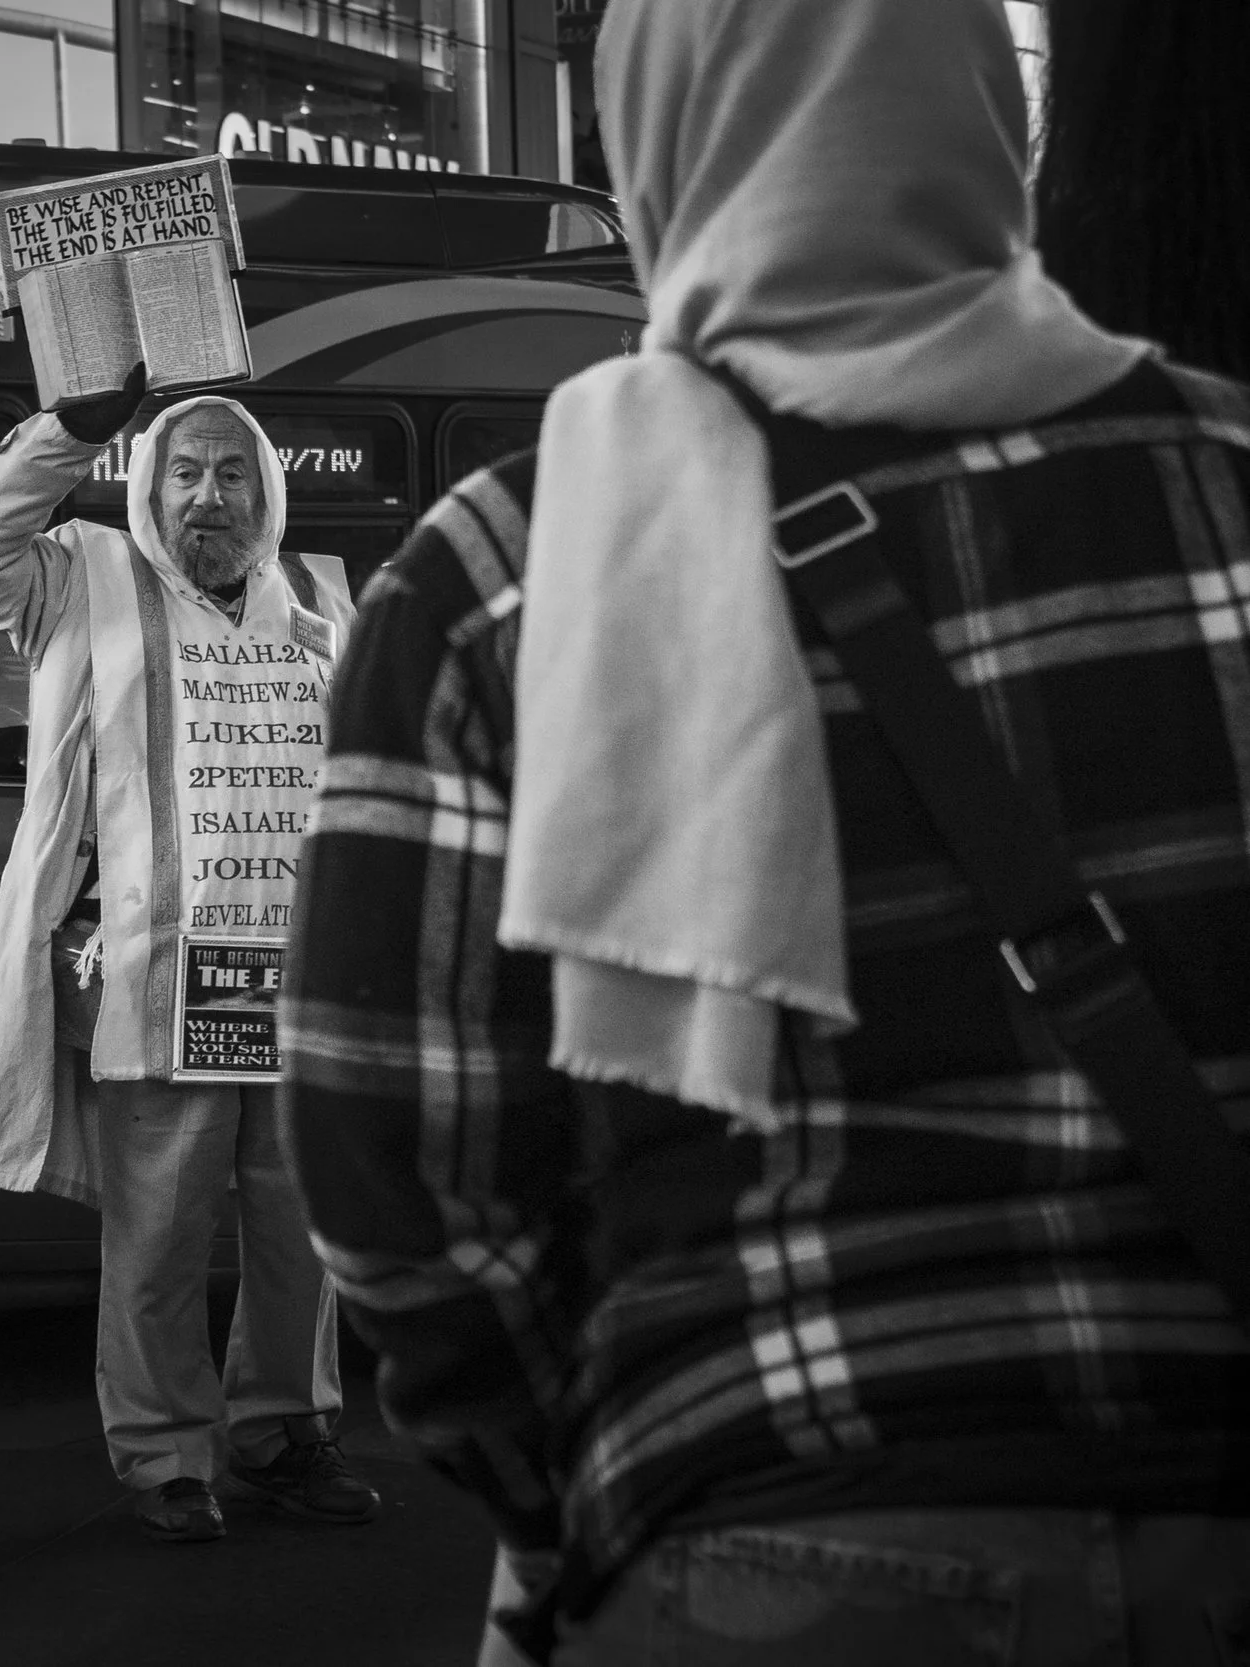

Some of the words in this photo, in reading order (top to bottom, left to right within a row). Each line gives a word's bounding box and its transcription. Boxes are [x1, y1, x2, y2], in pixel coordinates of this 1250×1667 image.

[6, 205, 29, 227] BE
[34, 196, 82, 220] WISE
[89, 187, 128, 211] AND
[131, 173, 208, 199] REPENT.
[11, 222, 53, 247] THE
[52, 212, 97, 236] TIME
[101, 208, 117, 230] IS
[122, 193, 217, 225] FULFILLED.
[14, 243, 56, 268] THE
[59, 235, 98, 260] END
[102, 229, 117, 252] IS
[122, 224, 147, 248] AT
[153, 215, 214, 241] HAND.
[331, 448, 362, 472] AV
[178, 640, 310, 665] ISAIAH.24
[186, 721, 323, 745] LUKE.21
[189, 766, 319, 789] 2PETER.
[190, 811, 309, 834] ISAIAH.
[195, 950, 220, 964] THE
[197, 965, 250, 988] THE
[186, 1020, 269, 1033] WHERE
[189, 1032, 246, 1043] WILL
[189, 1043, 234, 1053] YOU
